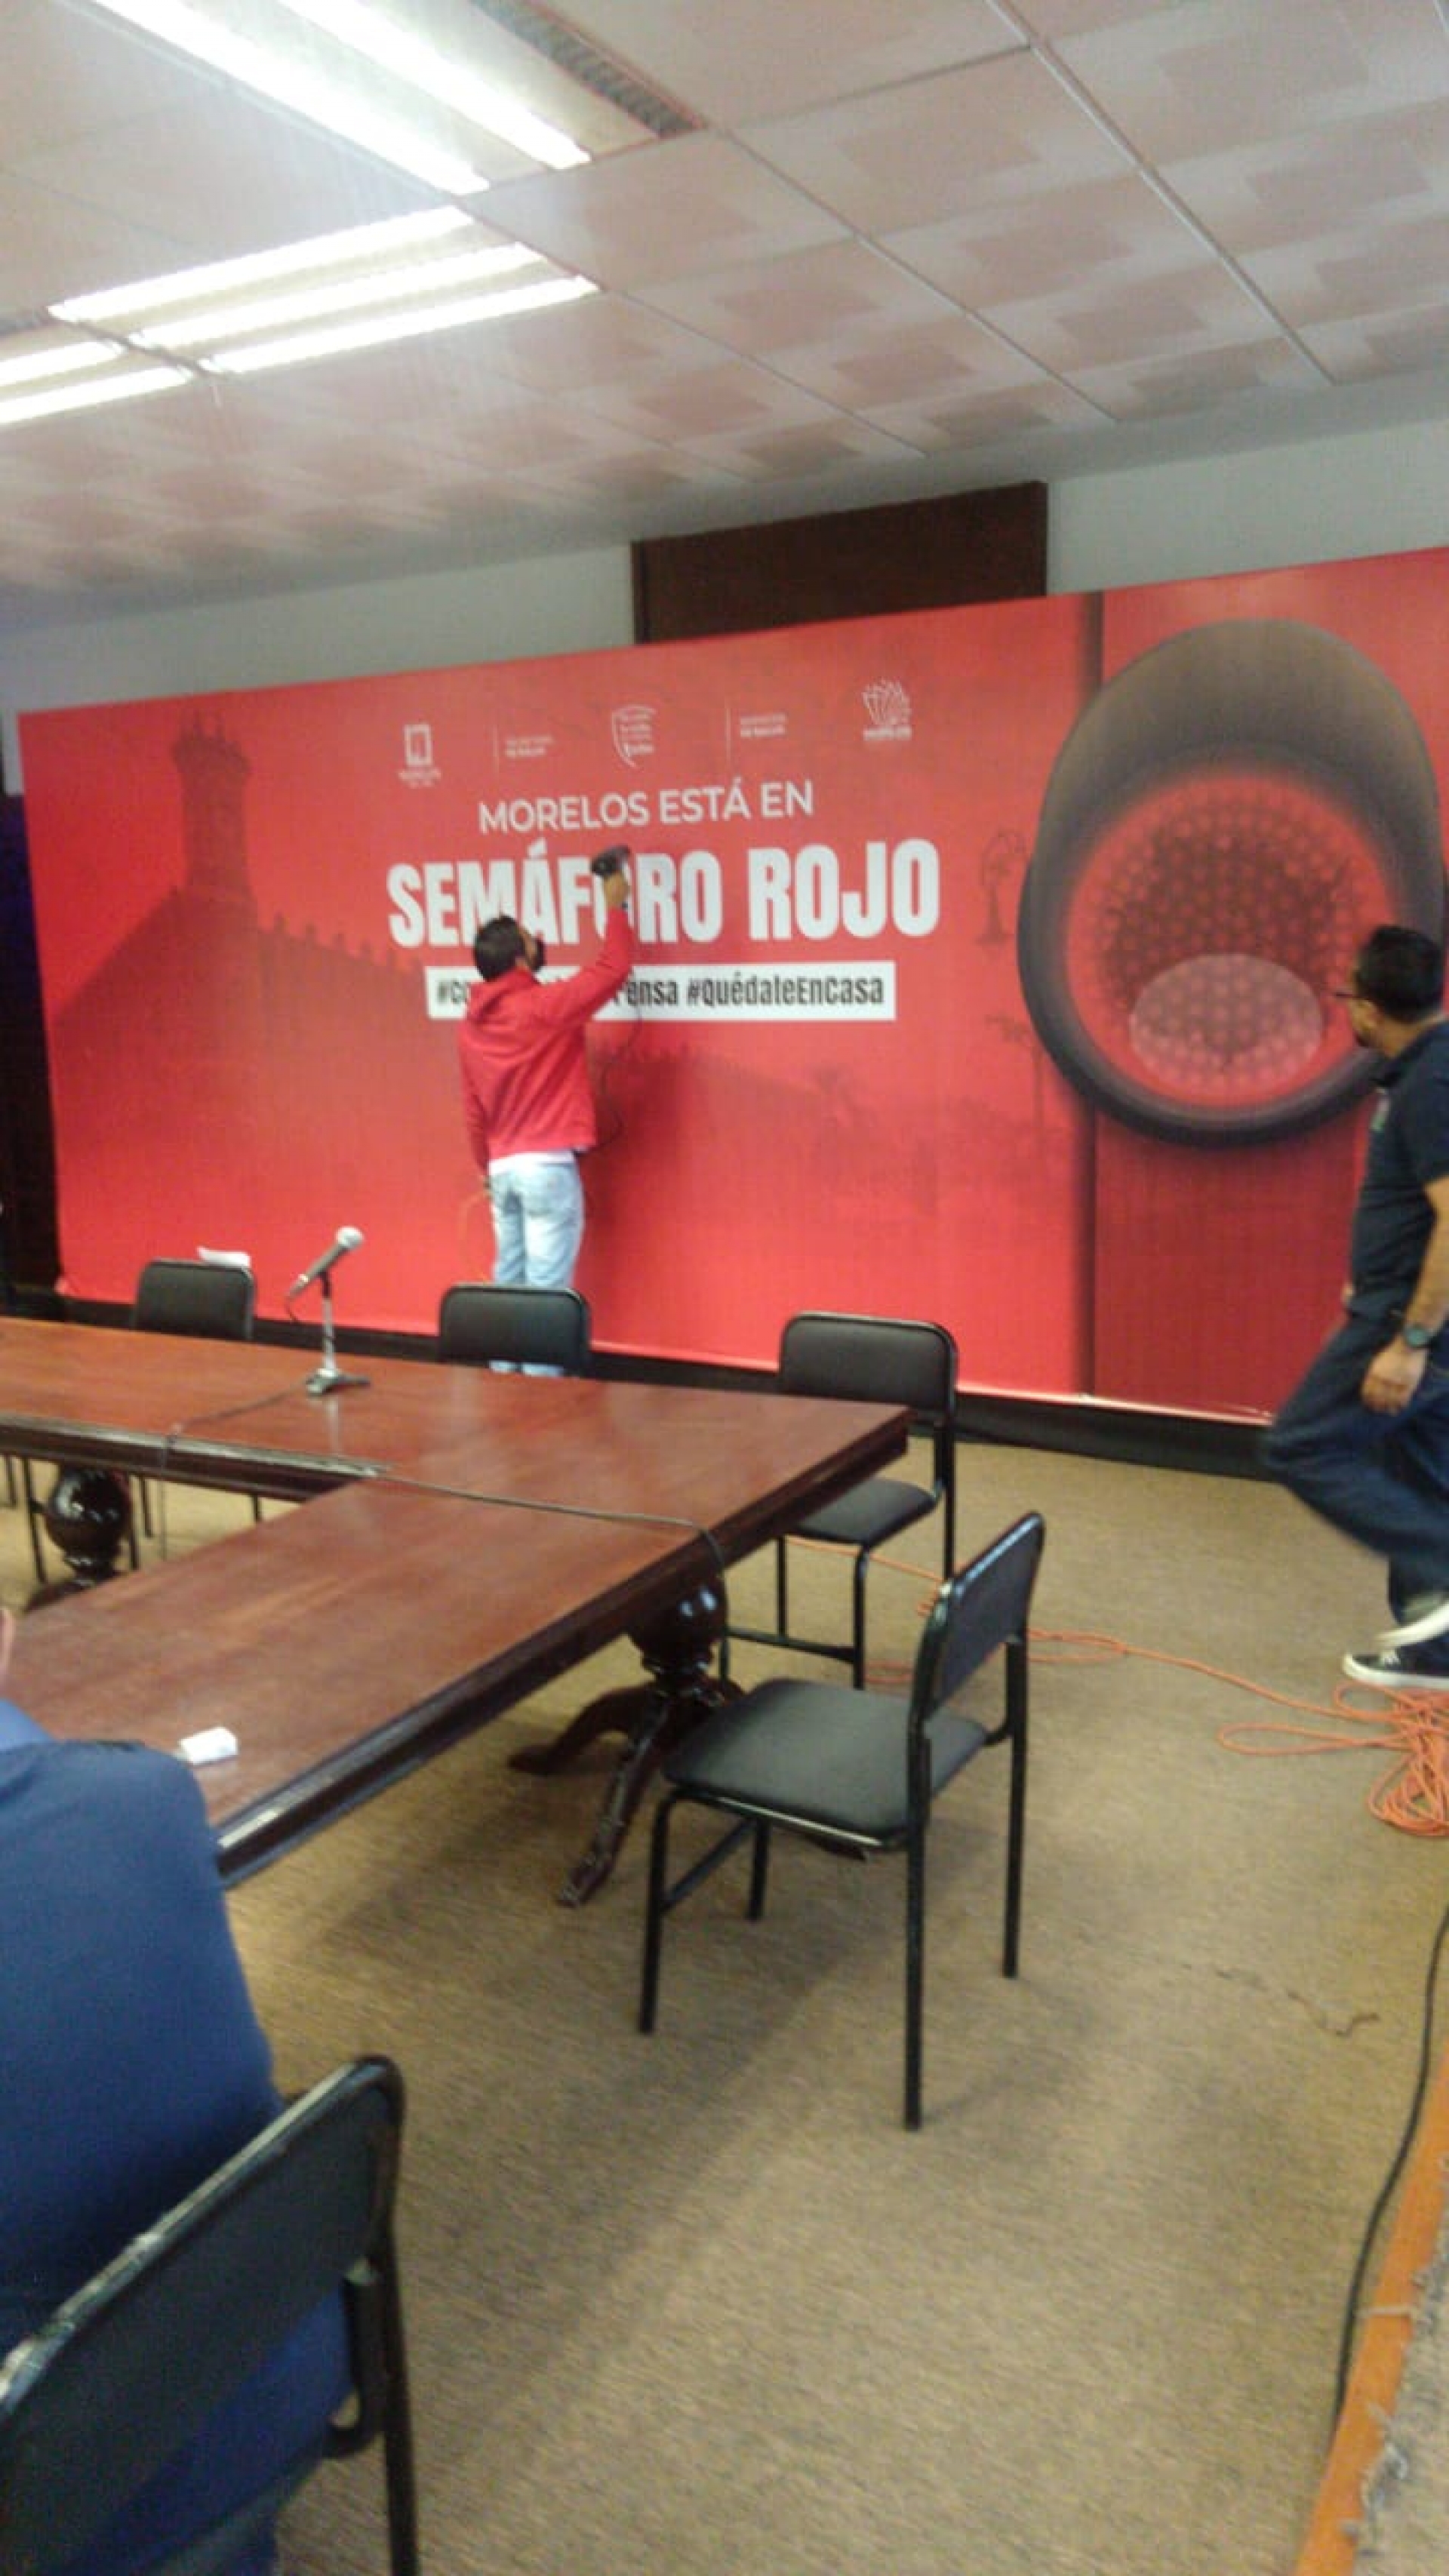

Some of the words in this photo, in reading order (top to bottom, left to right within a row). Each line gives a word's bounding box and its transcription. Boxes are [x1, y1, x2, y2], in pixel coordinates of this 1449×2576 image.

[478, 792, 650, 834] MORELOS
[659, 775, 752, 824] ESTÁ
[759, 779, 815, 817] EN
[747, 838, 940, 940] ROJO
